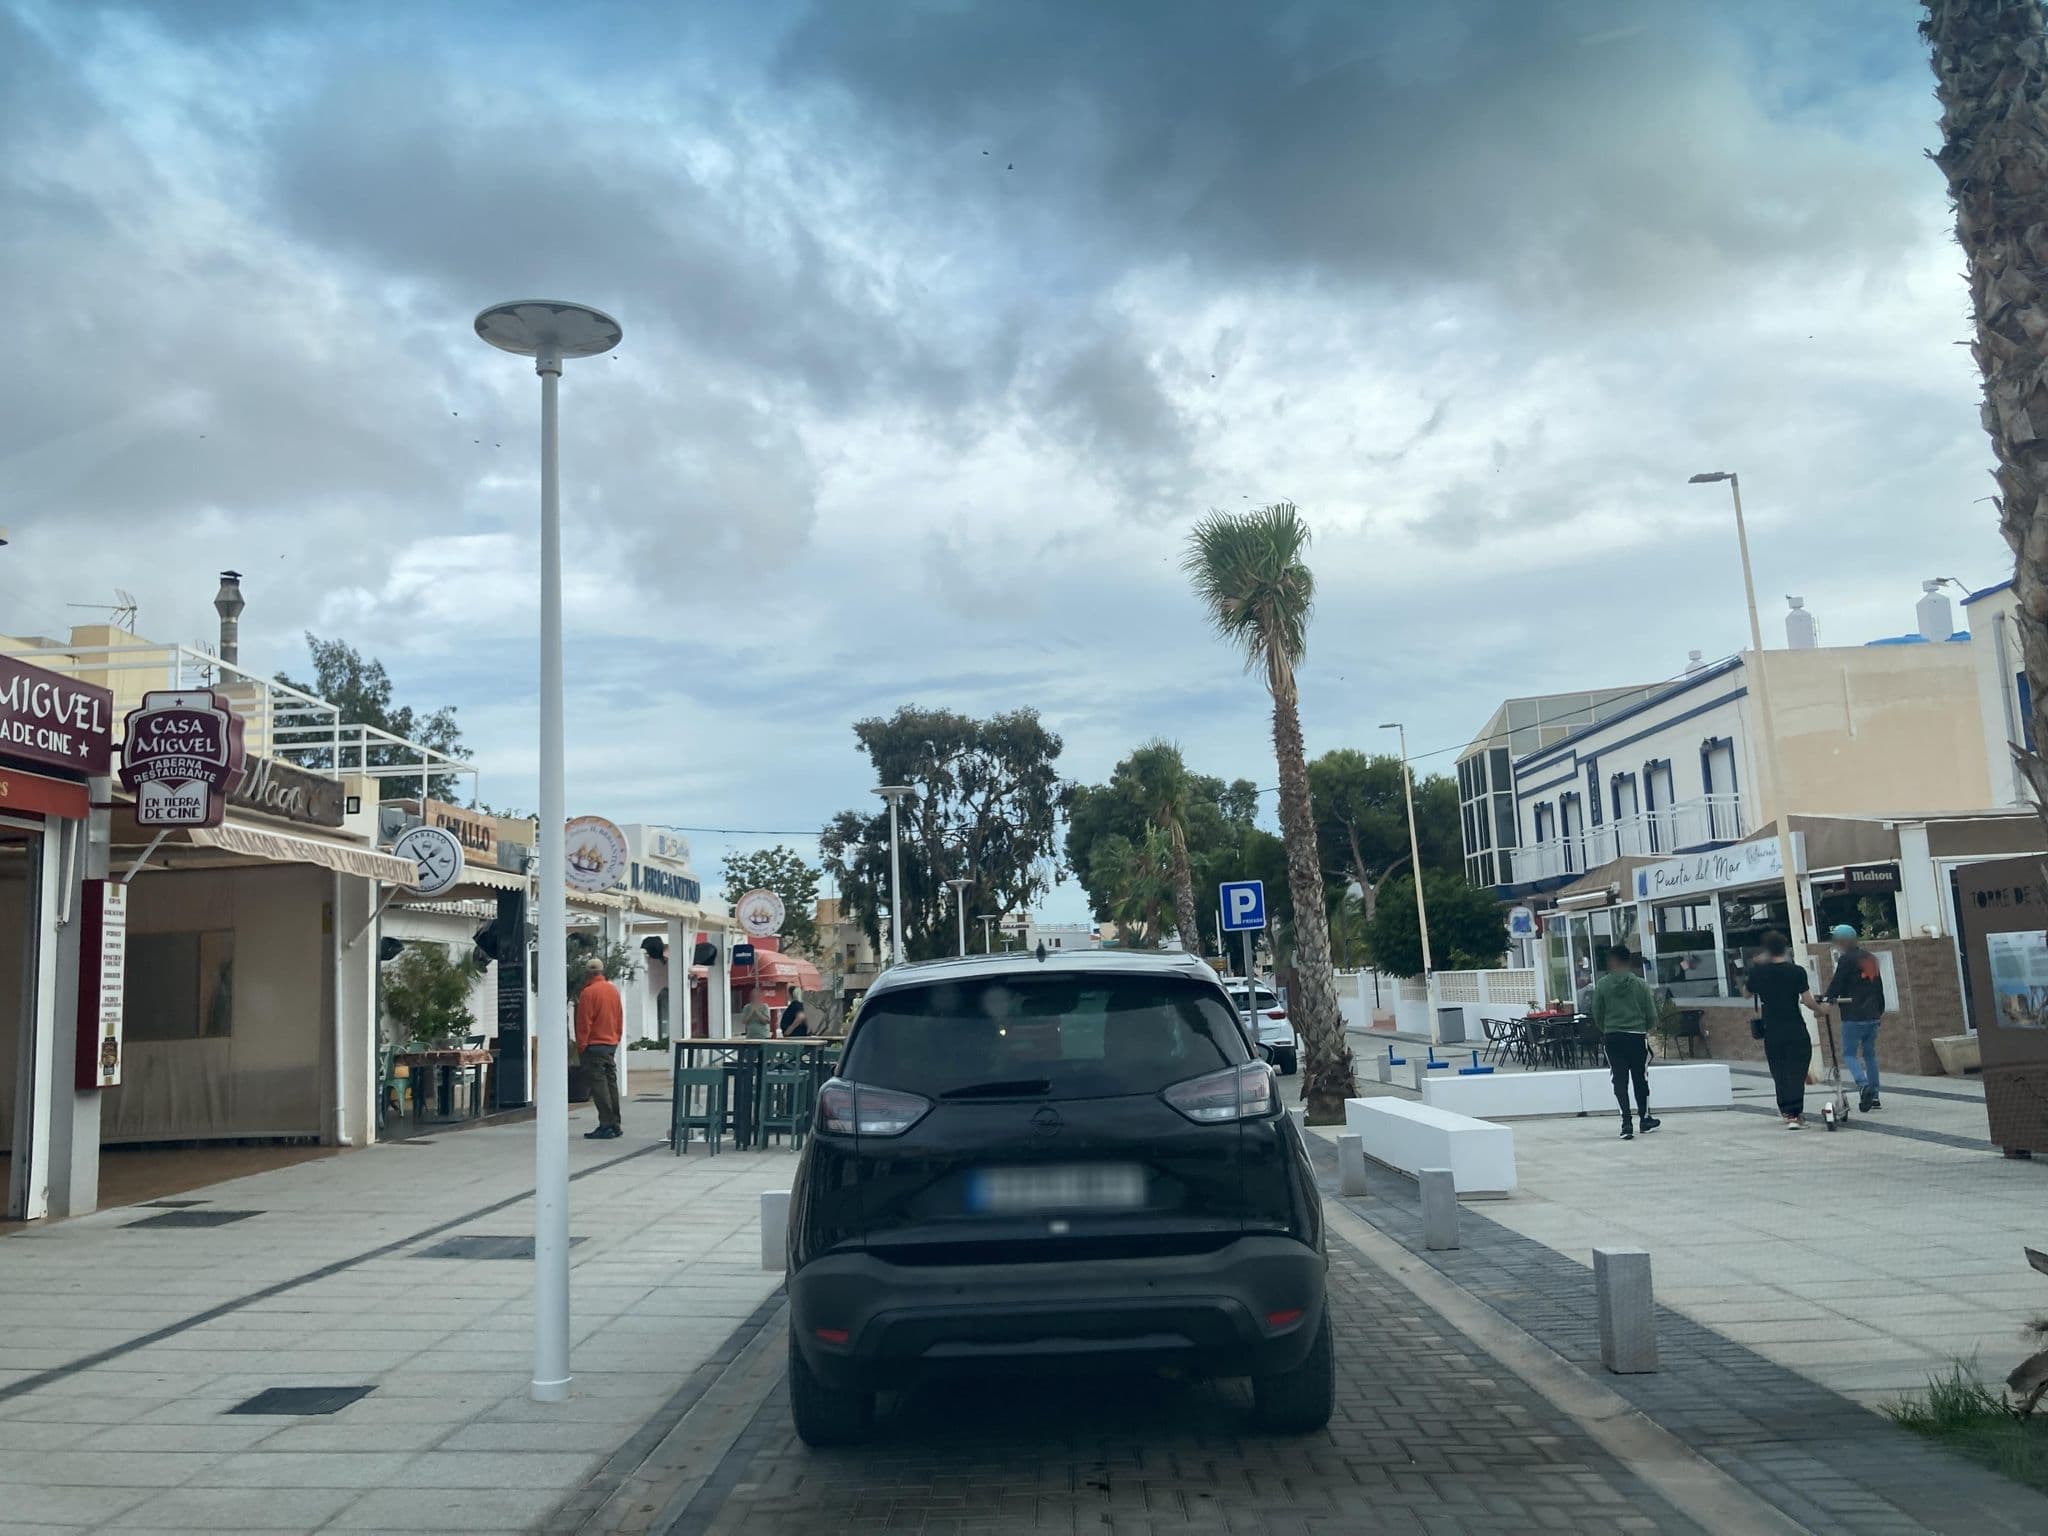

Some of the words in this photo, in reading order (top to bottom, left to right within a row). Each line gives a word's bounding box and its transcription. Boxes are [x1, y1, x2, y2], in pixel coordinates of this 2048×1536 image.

[150, 717, 203, 735] CASA
[13, 721, 34, 746] DE
[37, 729, 72, 755] CINE
[148, 759, 202, 771] TABERNA
[133, 767, 217, 784] RESTAURANTE
[145, 797, 161, 808] EN
[163, 797, 201, 808] TIERRA
[144, 807, 164, 819] DE
[167, 807, 201, 819] CINE
[1654, 863, 1690, 893] Puerta
[1695, 857, 1709, 881] del
[1713, 855, 1741, 881] Mar
[1852, 870, 1893, 882] Mahou
[1230, 888, 1256, 925] P
